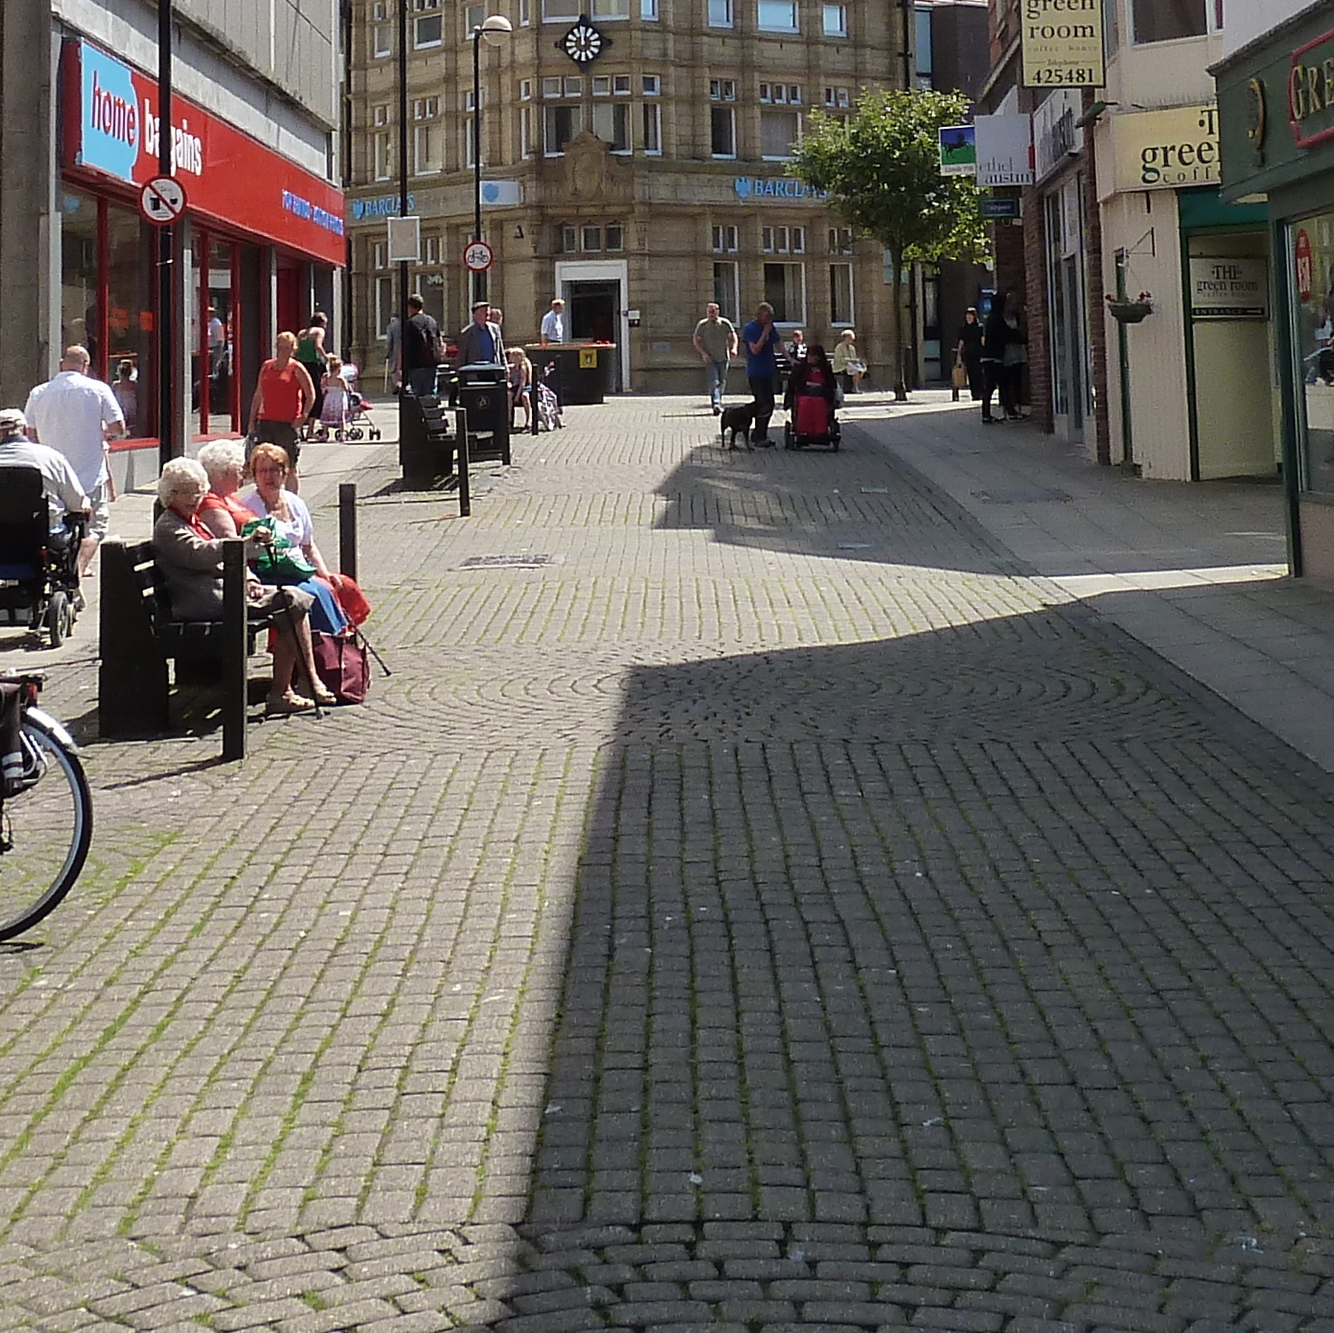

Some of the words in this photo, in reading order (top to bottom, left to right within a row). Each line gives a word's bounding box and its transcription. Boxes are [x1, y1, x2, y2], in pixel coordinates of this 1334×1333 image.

[1029, 25, 1095, 39] room
[1033, 68, 1094, 84] 425481
[91, 70, 136, 148] home
[144, 98, 203, 176] bagains
[979, 157, 1013, 172] ethel
[1141, 141, 1220, 184] gree
[985, 172, 1030, 184] austin
[365, 194, 416, 216] BARCLAS
[1196, 281, 1227, 294] green
[1230, 281, 1258, 291] room
